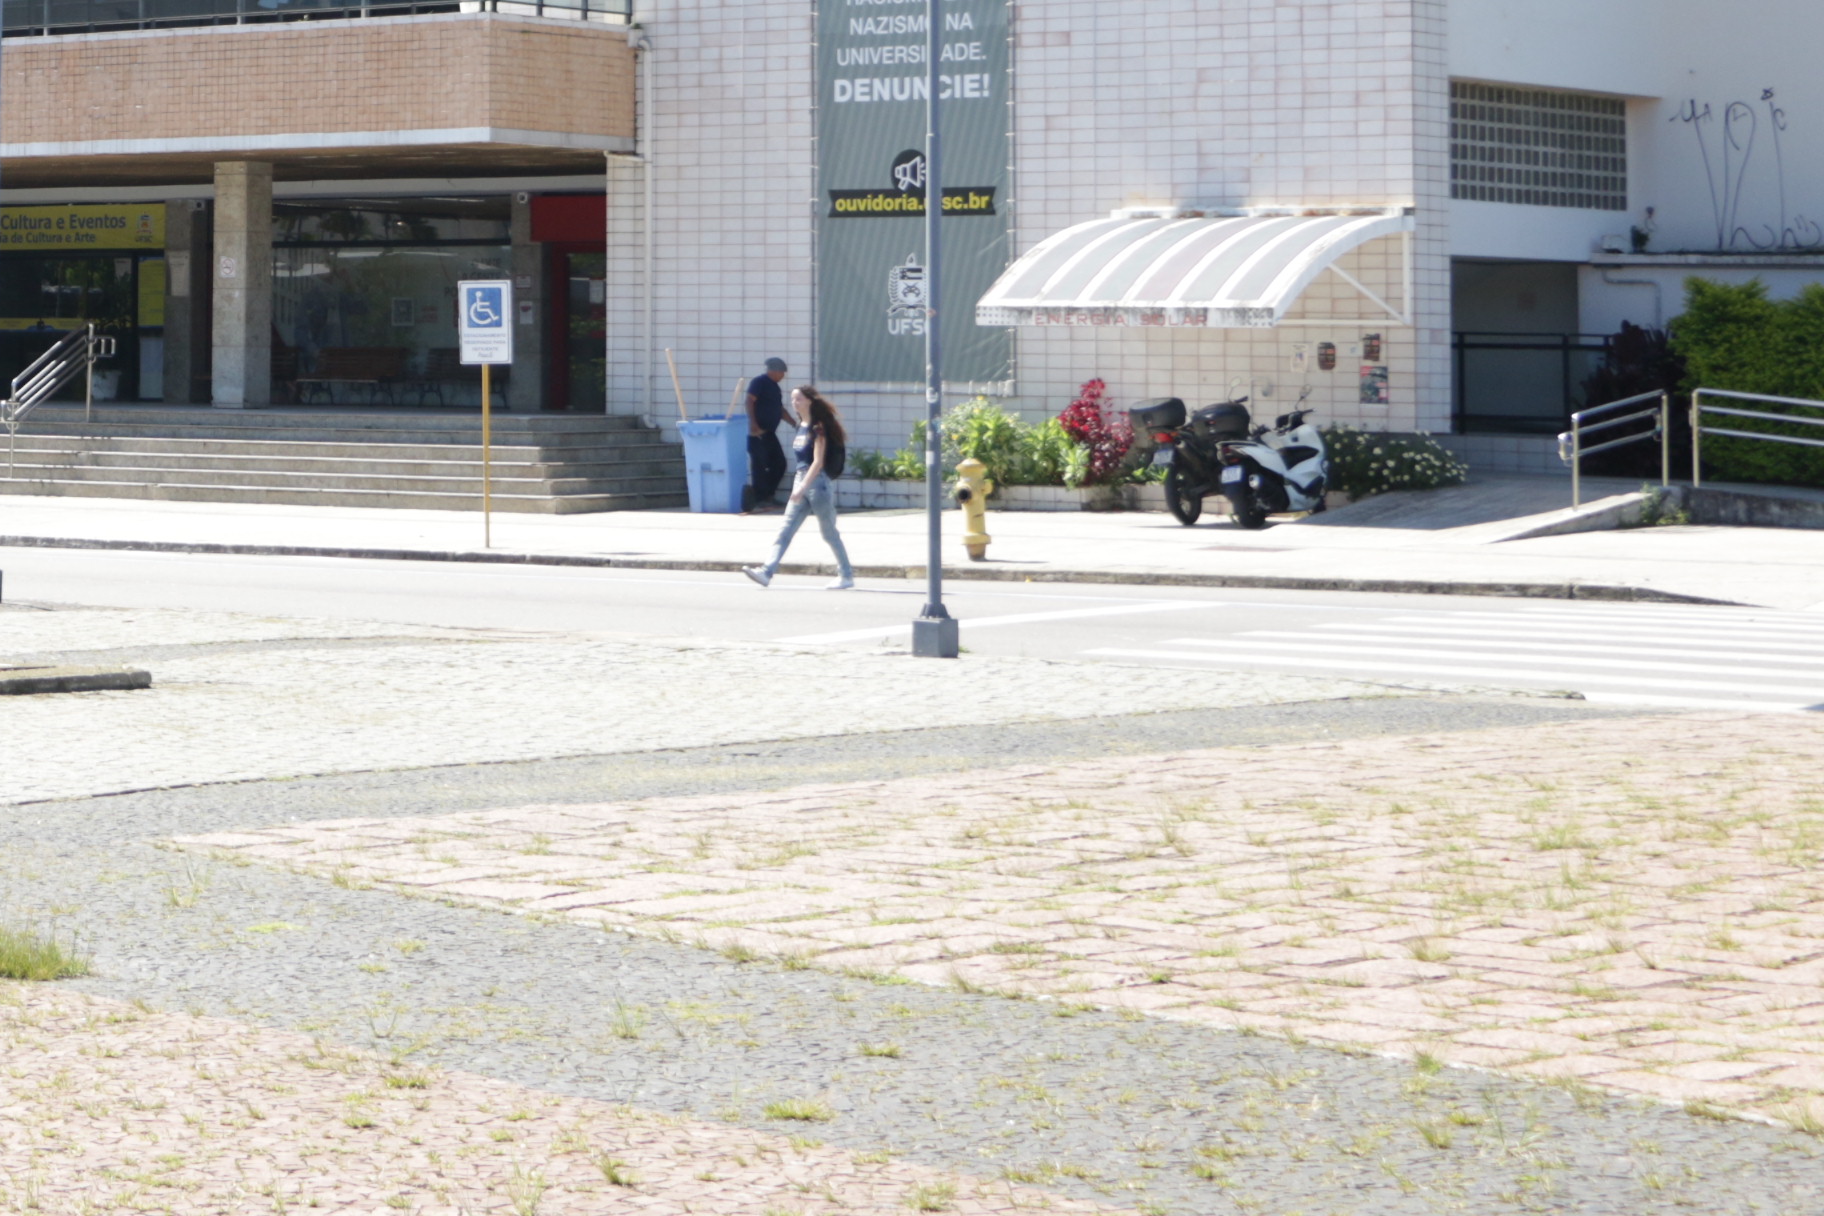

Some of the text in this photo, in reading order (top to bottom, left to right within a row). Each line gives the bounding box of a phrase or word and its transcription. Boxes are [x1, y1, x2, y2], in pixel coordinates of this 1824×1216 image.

[945, 12, 974, 31] NA
[836, 41, 987, 66] UNIVERSIADE.
[835, 192, 990, 212] ouvidoria.sc.br
[0, 214, 52, 230] Cultura
[56, 216, 65, 229] e
[69, 212, 126, 229] Eventos
[11, 232, 24, 243] de
[26, 231, 63, 243] Cultura
[74, 231, 97, 242] Arte
[887, 318, 926, 335] UFS
[1034, 312, 1209, 326] ENERGIA SOLAR
